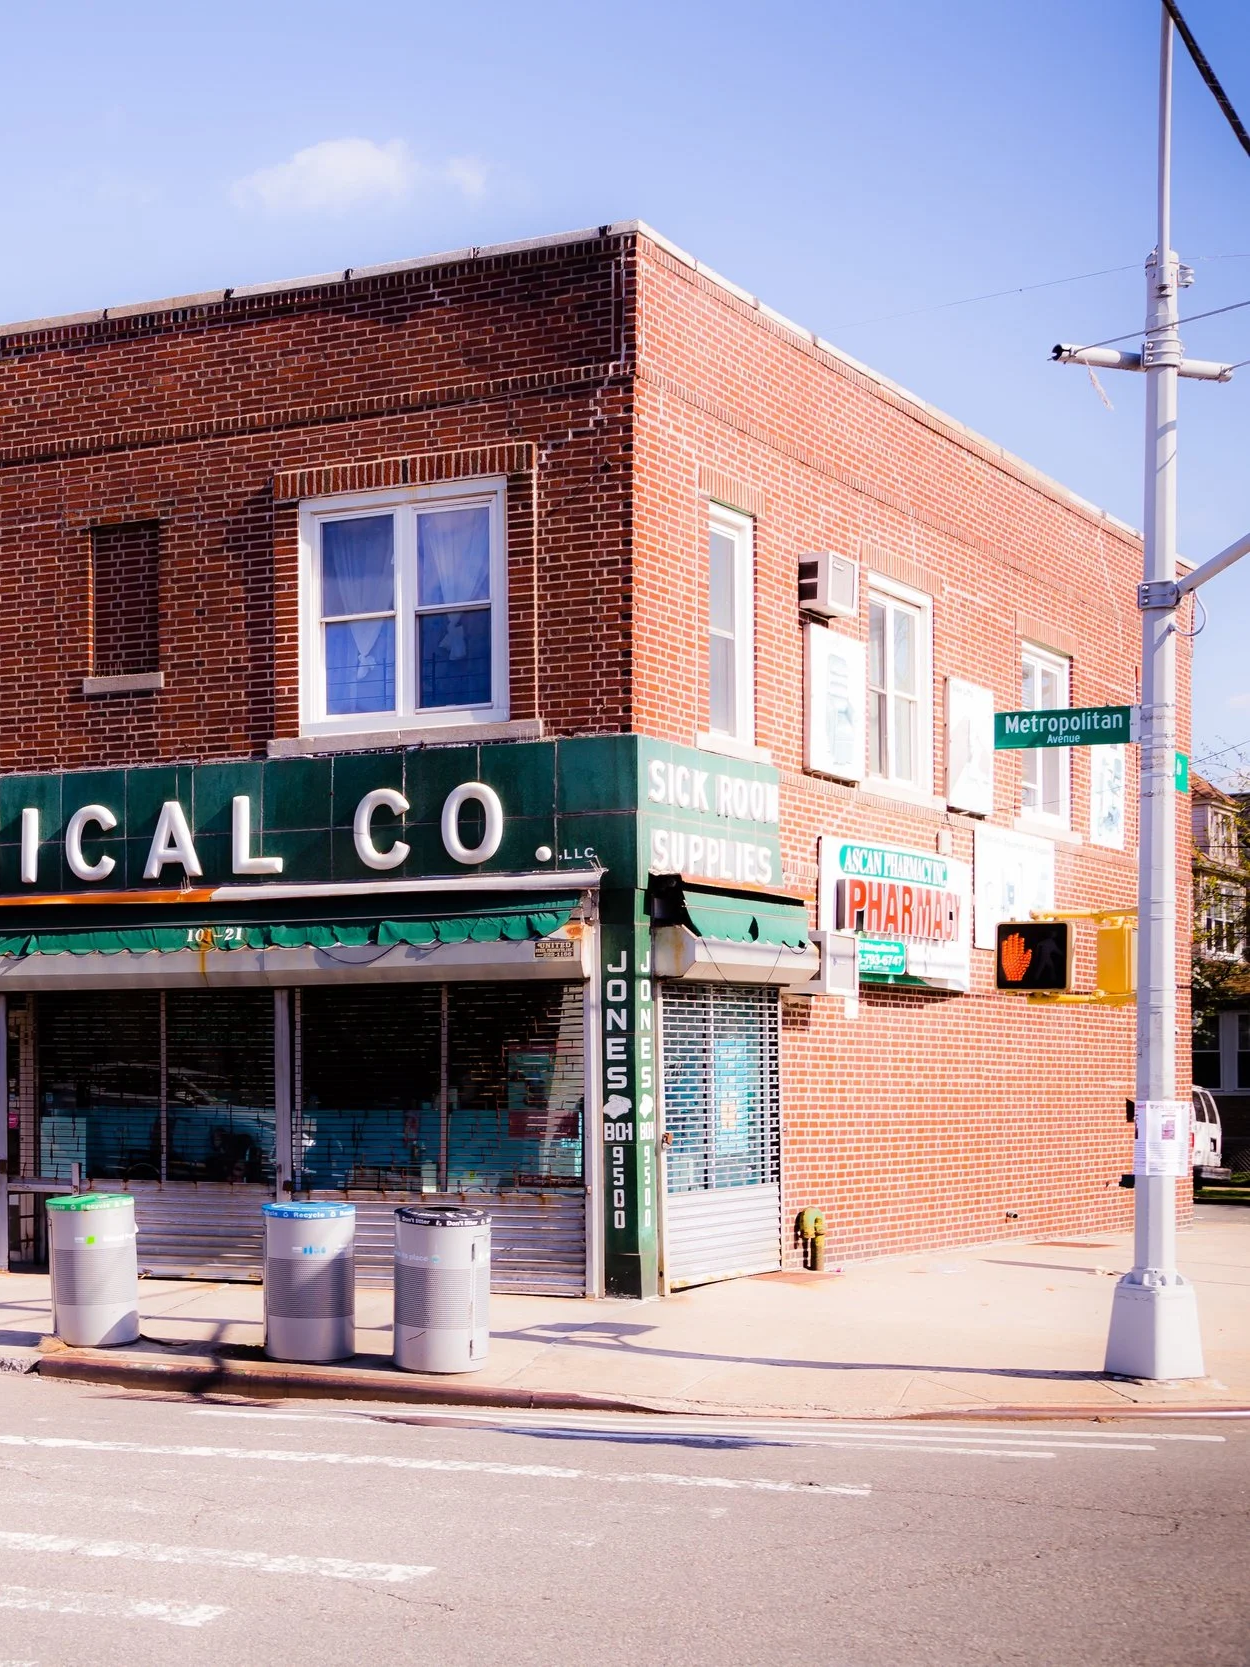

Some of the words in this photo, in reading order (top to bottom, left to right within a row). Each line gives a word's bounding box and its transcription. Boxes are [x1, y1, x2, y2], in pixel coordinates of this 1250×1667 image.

[1005, 712, 1122, 735] Metropolitan
[1047, 734, 1080, 744] Avenue
[649, 760, 709, 812] SICK
[651, 829, 772, 884] SUPPLIES
[843, 846, 882, 876] ASCAN
[884, 853, 931, 883] PHARMACY
[849, 878, 961, 941] PHARMACY
[606, 950, 627, 1089] JONES
